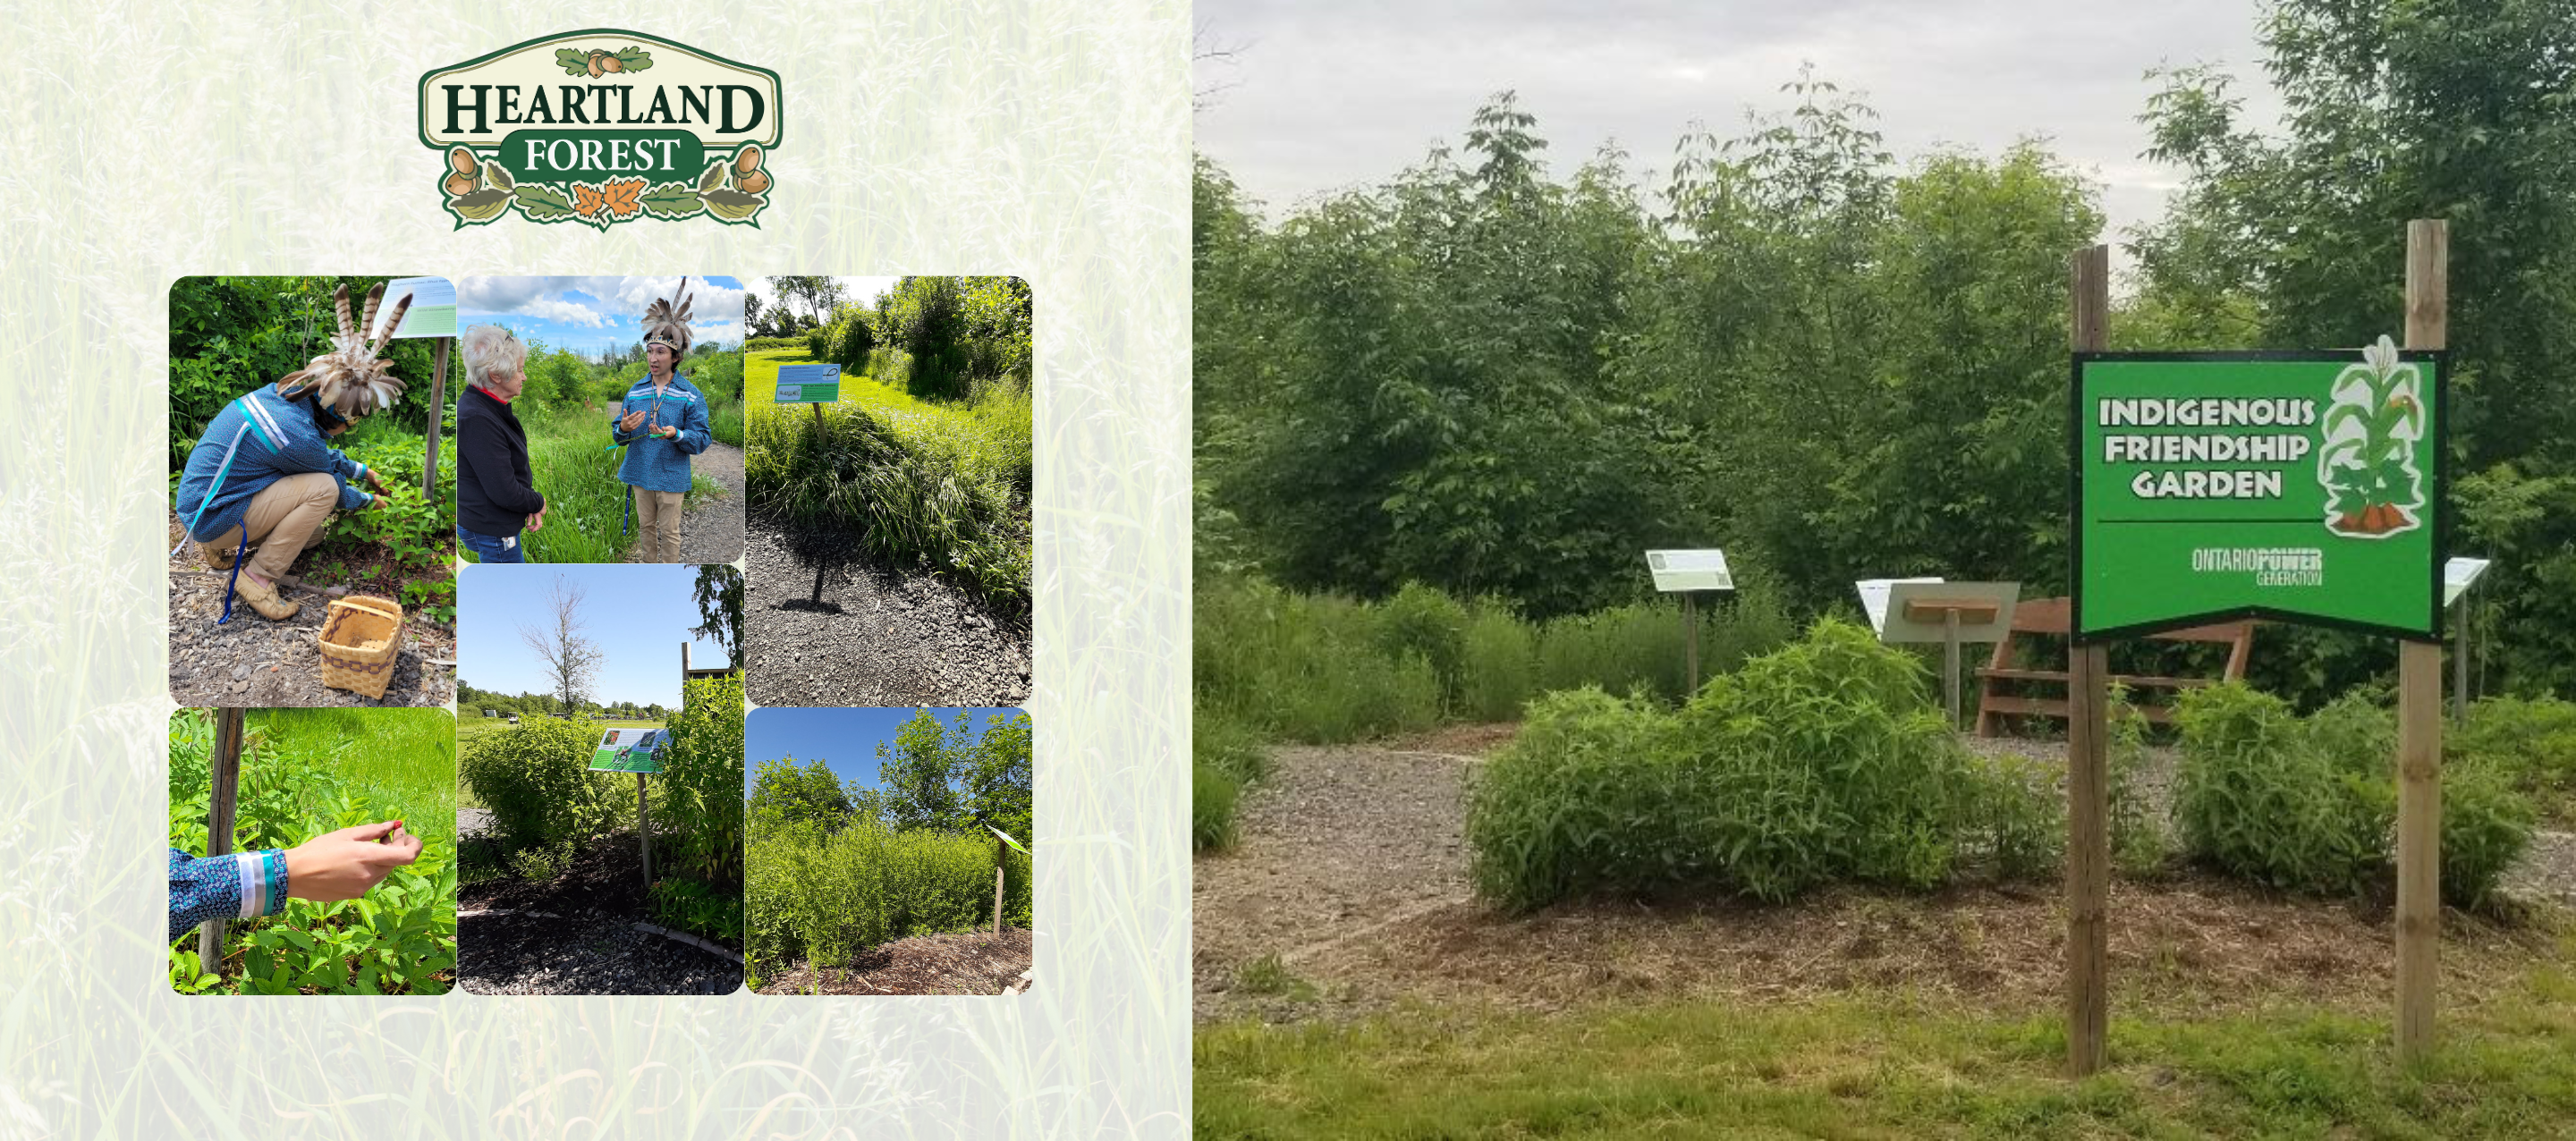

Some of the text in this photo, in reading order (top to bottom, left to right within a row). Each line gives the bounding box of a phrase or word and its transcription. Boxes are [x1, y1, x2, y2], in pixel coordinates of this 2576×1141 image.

[2098, 398, 2317, 427] INDIGENOUS
[2104, 435, 2311, 463] FRIENDSHIP
[2131, 470, 2283, 499] GARDEN
[2256, 571, 2322, 586] GENERATION
